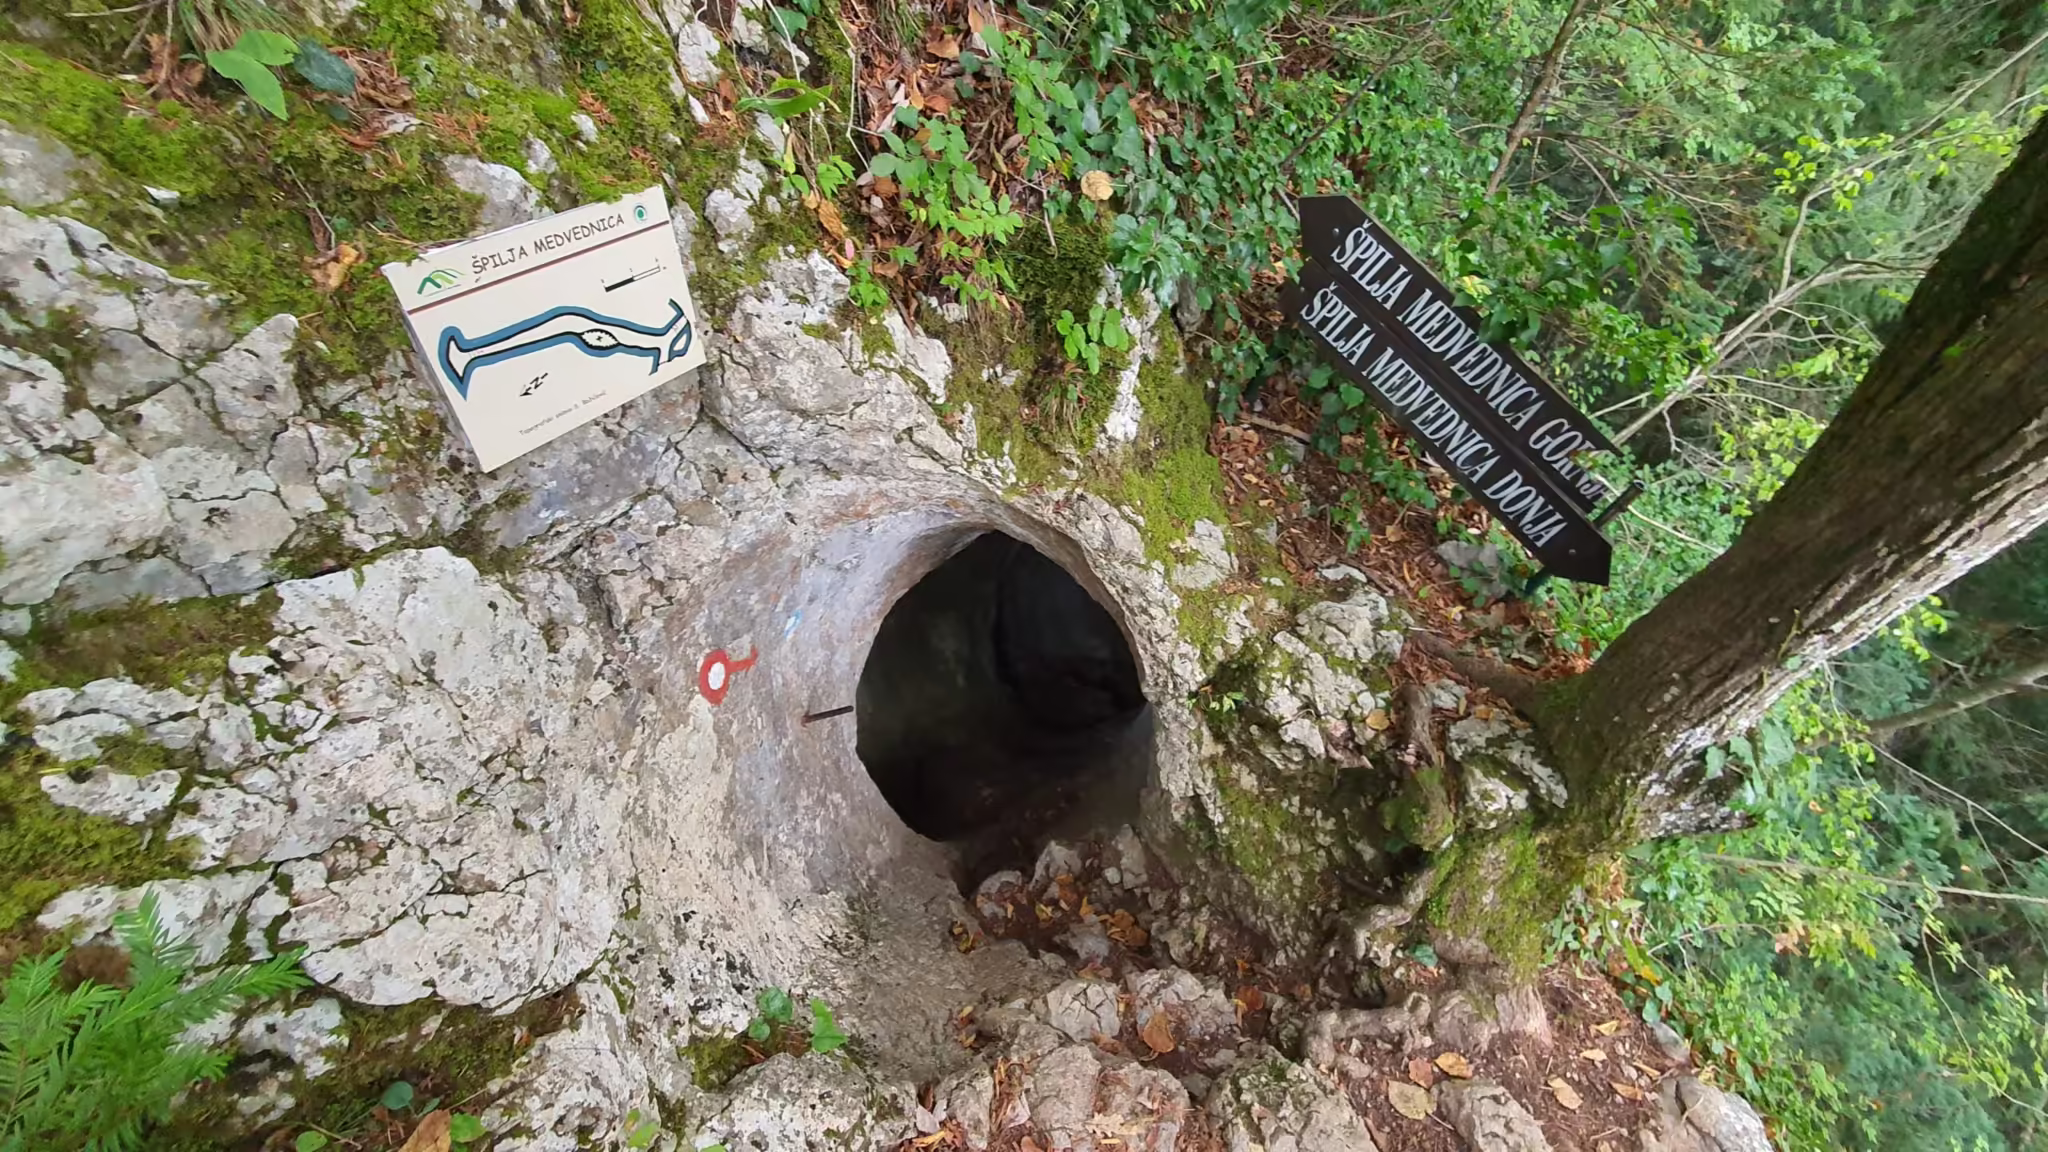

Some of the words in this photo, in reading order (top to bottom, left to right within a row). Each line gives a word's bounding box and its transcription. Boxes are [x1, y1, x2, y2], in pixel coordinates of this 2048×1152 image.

[471, 245, 529, 275] ŠPILJA
[533, 213, 625, 255] MEDVEDNICA
[1330, 218, 1414, 311] ŠPILJA
[1396, 287, 1547, 432] MEDVEDNICA
[1299, 280, 1377, 366] ŠPILJA
[1360, 346, 1502, 484] MEDVEDNICA
[1481, 468, 1569, 548] DONJA
